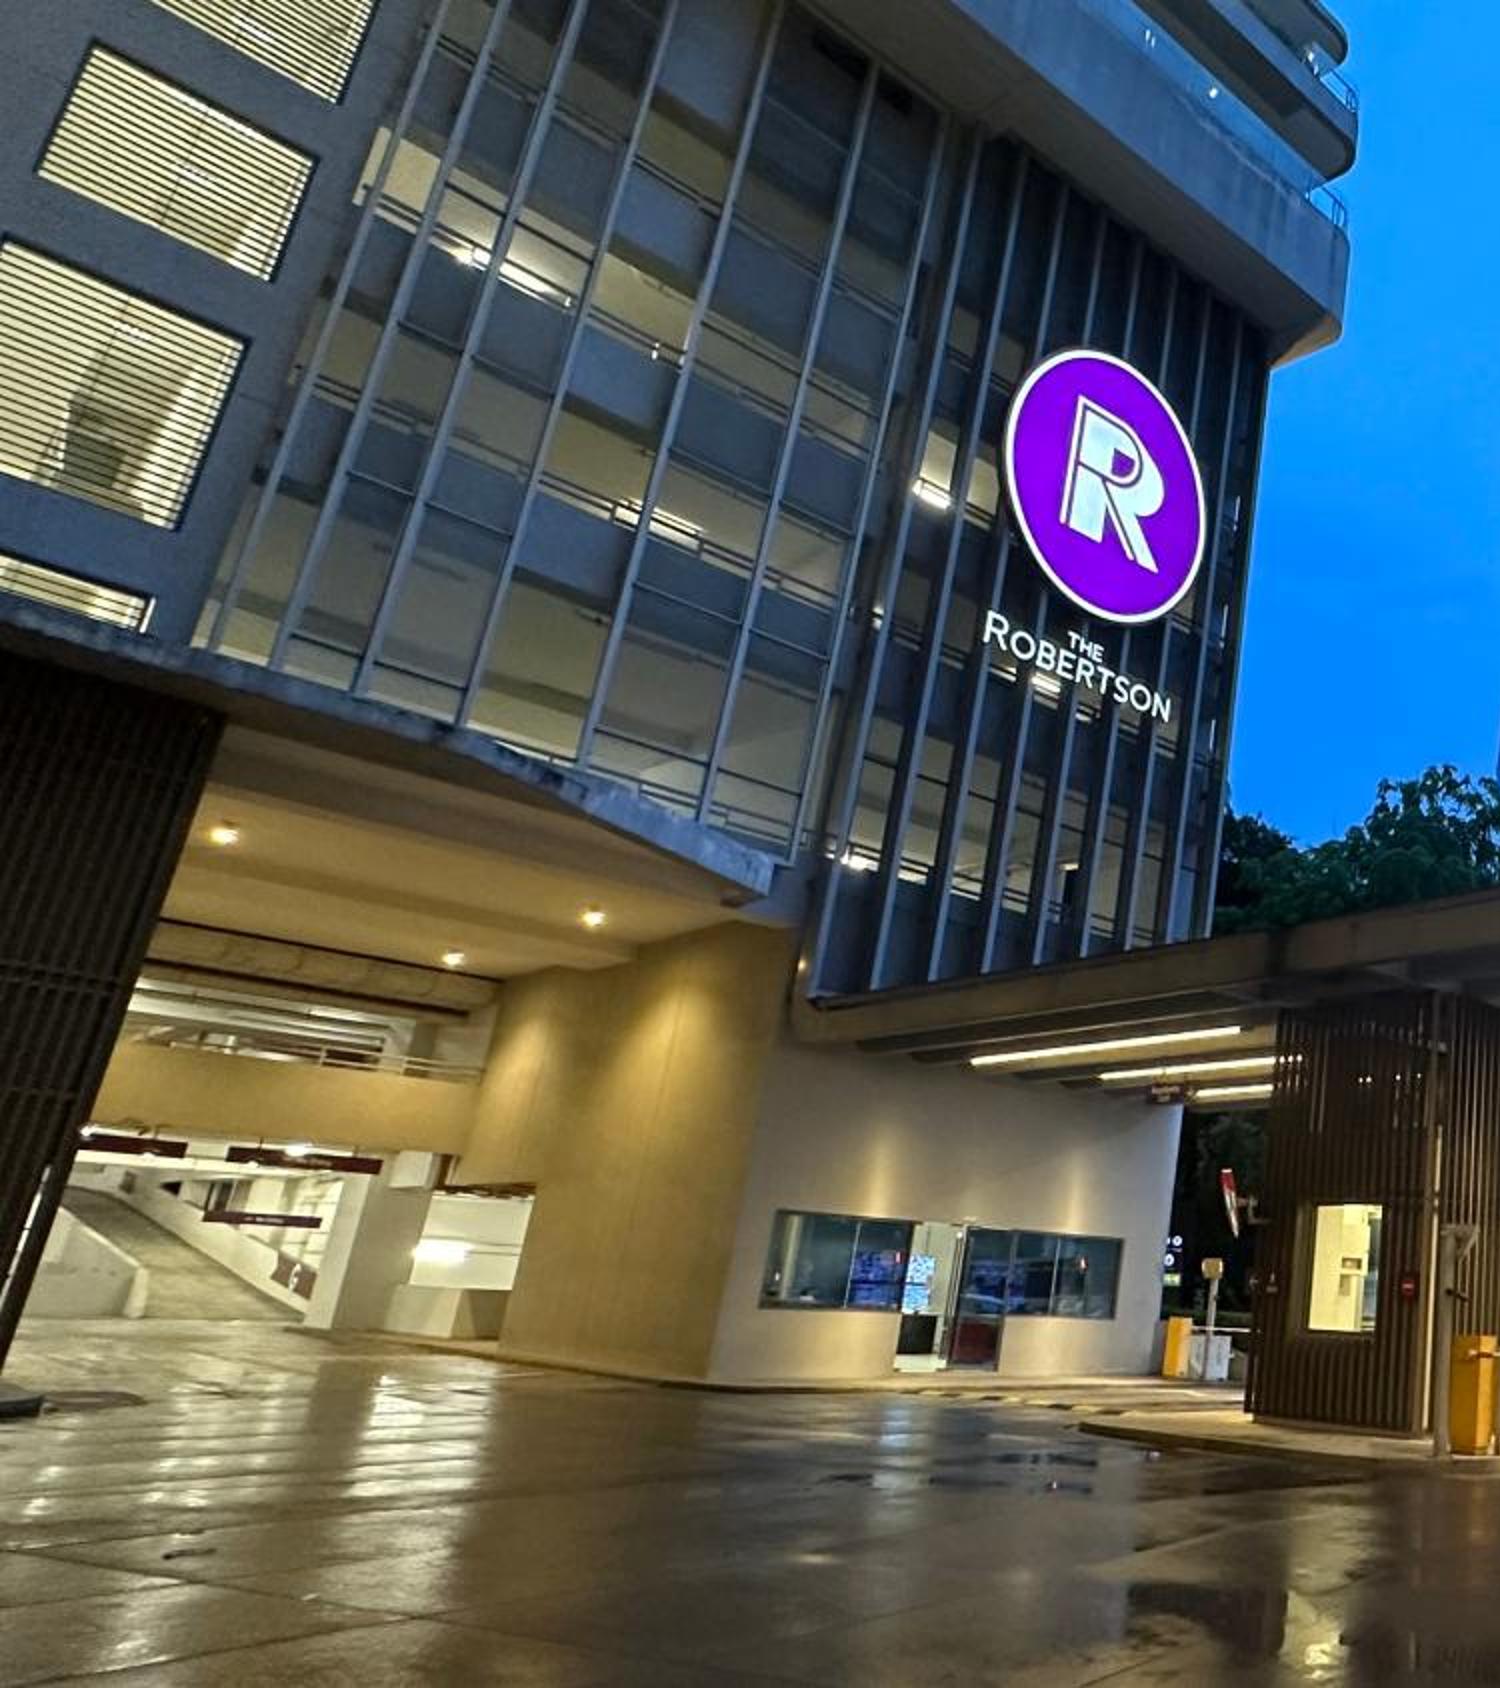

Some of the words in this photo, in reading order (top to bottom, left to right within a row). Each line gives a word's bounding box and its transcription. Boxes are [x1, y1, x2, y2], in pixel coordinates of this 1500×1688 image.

[1058, 394, 1166, 575] R
[982, 609, 1172, 723] ROBERTSON
[1067, 630, 1105, 663] THE
